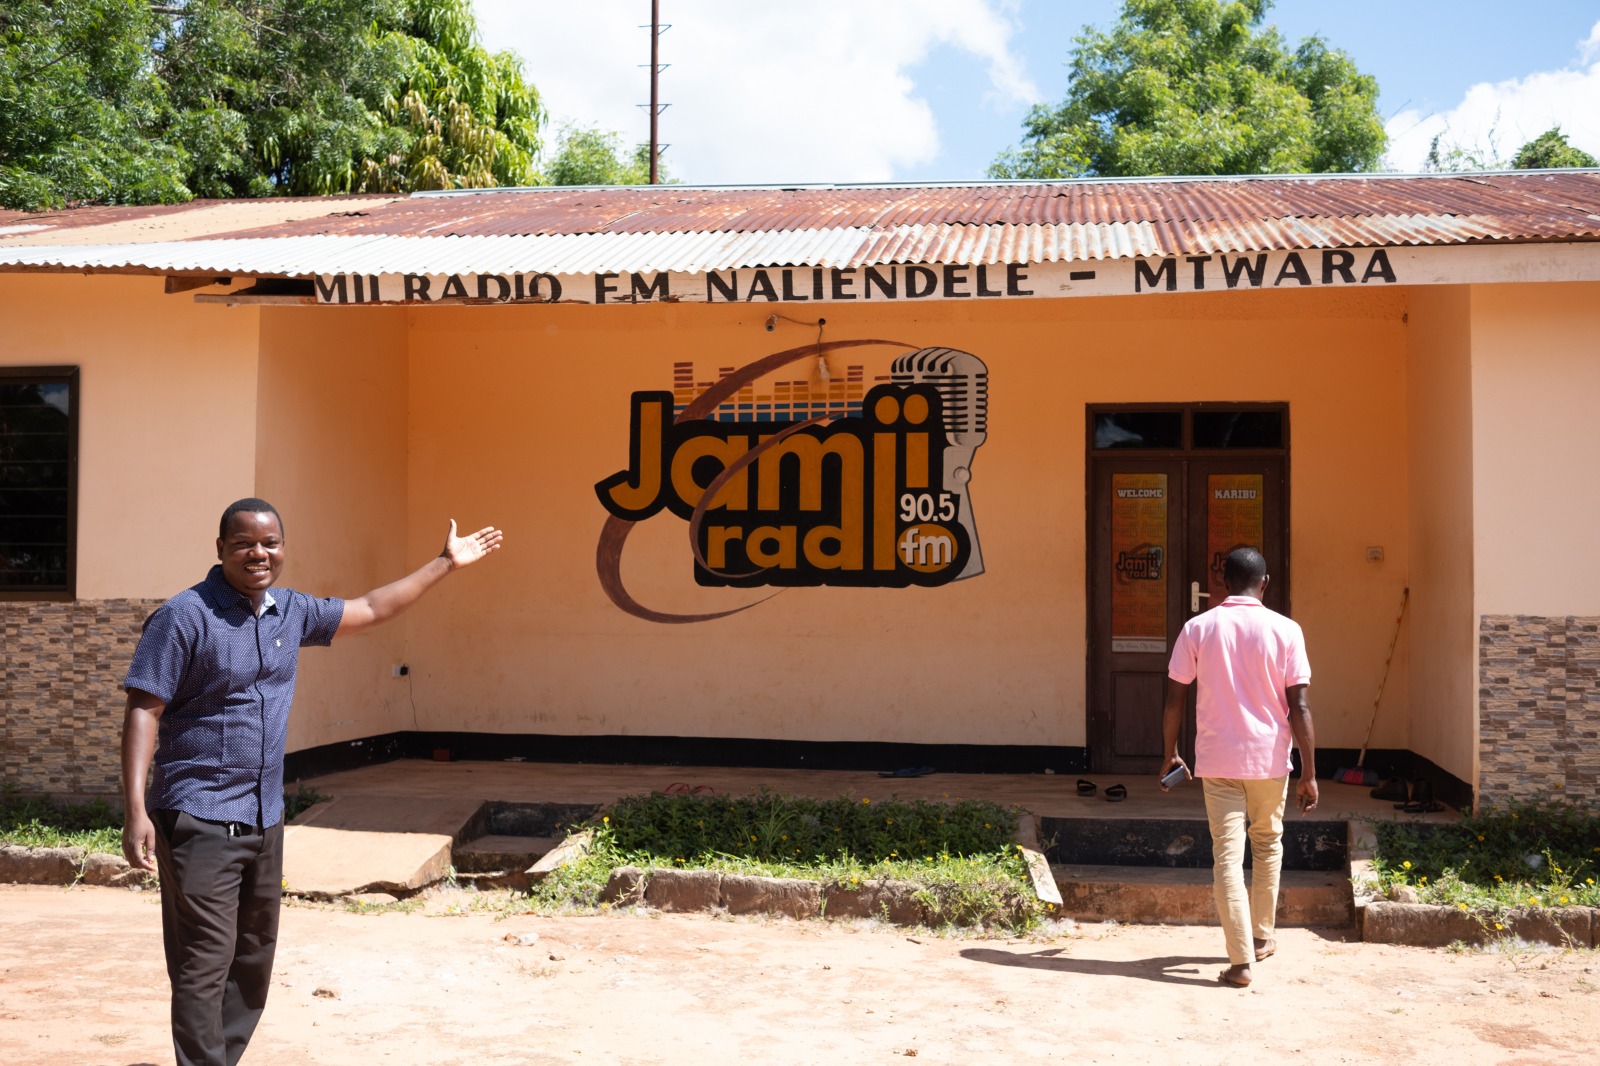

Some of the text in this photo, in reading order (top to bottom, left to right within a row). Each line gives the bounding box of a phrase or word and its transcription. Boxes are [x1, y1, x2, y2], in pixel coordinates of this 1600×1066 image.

[404, 271, 562, 303] RADIO
[595, 271, 669, 304] FM
[706, 264, 1034, 301] NALIENDELE
[1135, 249, 1398, 292] MTWARA
[608, 393, 929, 511] Jamii
[900, 493, 955, 522] 90.5
[1117, 489, 1163, 498] WELCOME
[1214, 489, 1257, 499] KARIBU
[900, 528, 953, 566] fm
[1118, 553, 1157, 570] Jamii
